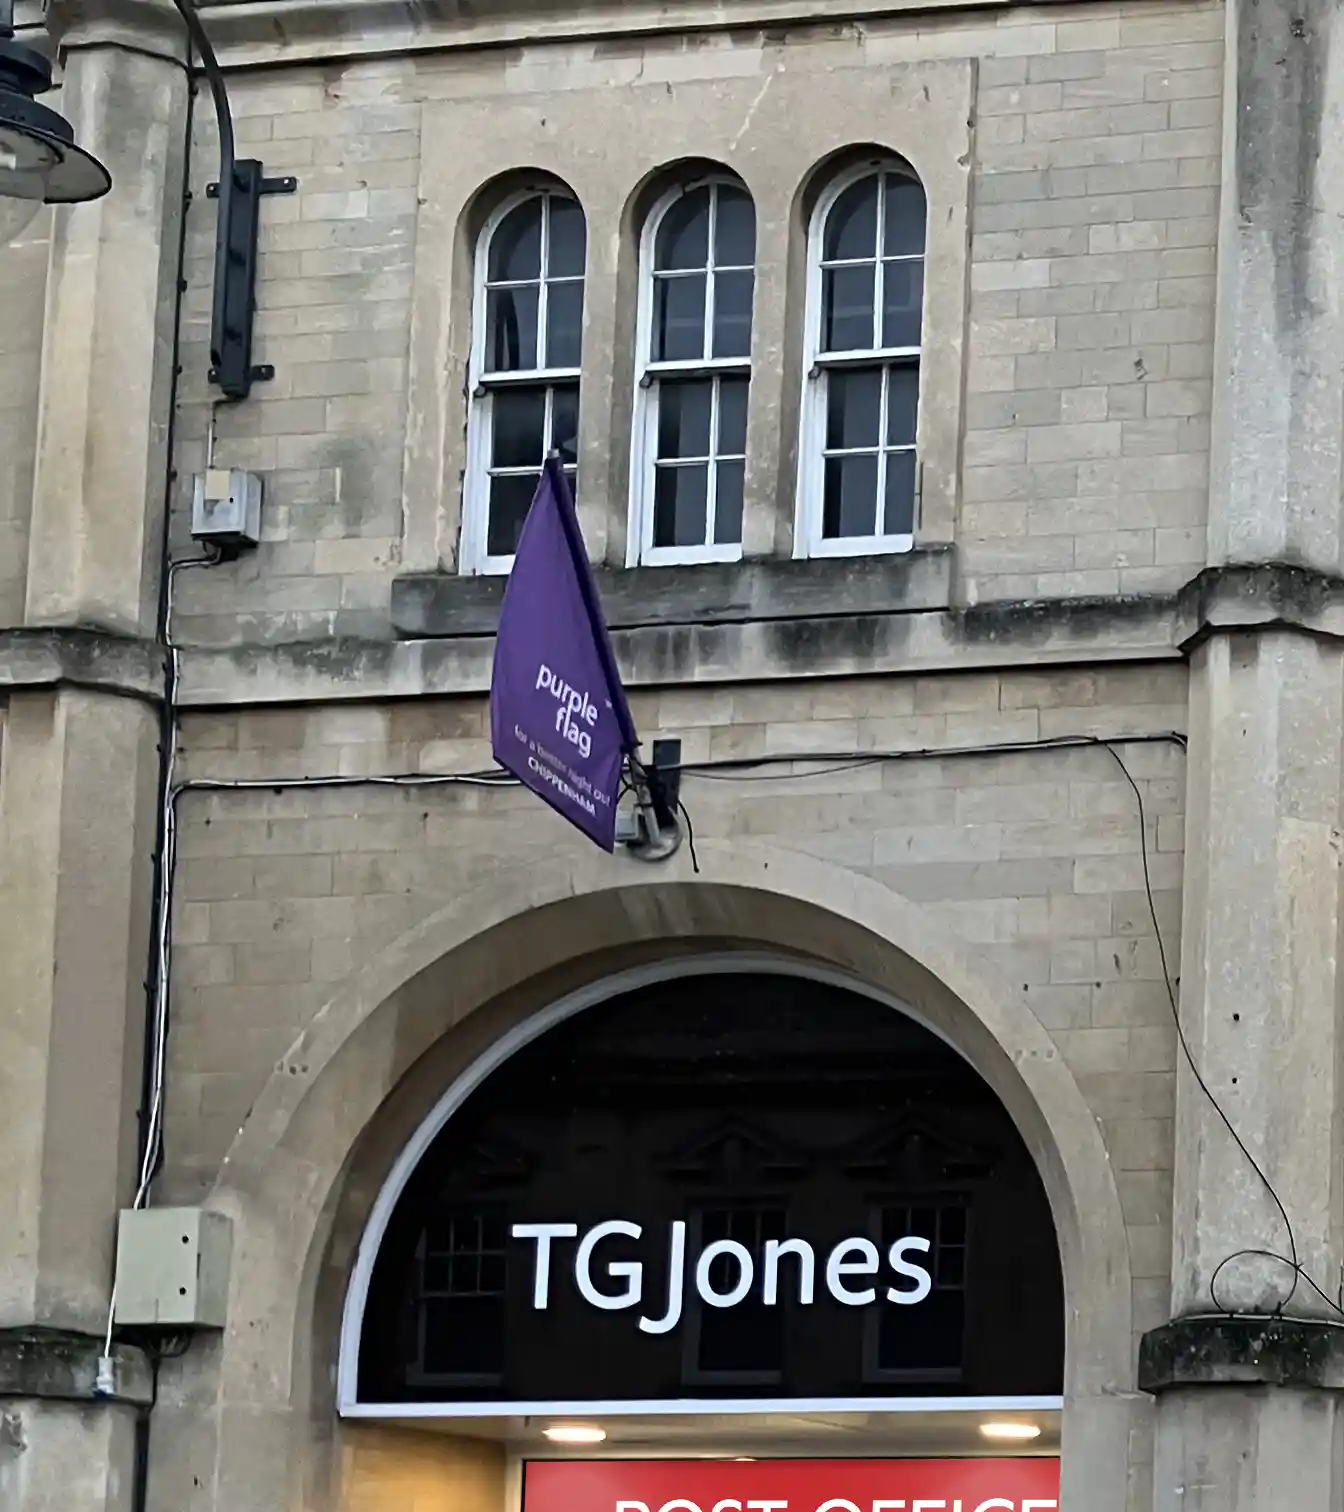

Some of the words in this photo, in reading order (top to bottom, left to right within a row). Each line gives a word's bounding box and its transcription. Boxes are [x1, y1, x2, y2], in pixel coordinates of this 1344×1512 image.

[536, 664, 598, 726] purple
[556, 705, 592, 758] flag
[528, 756, 597, 818] CHIPPENHAM
